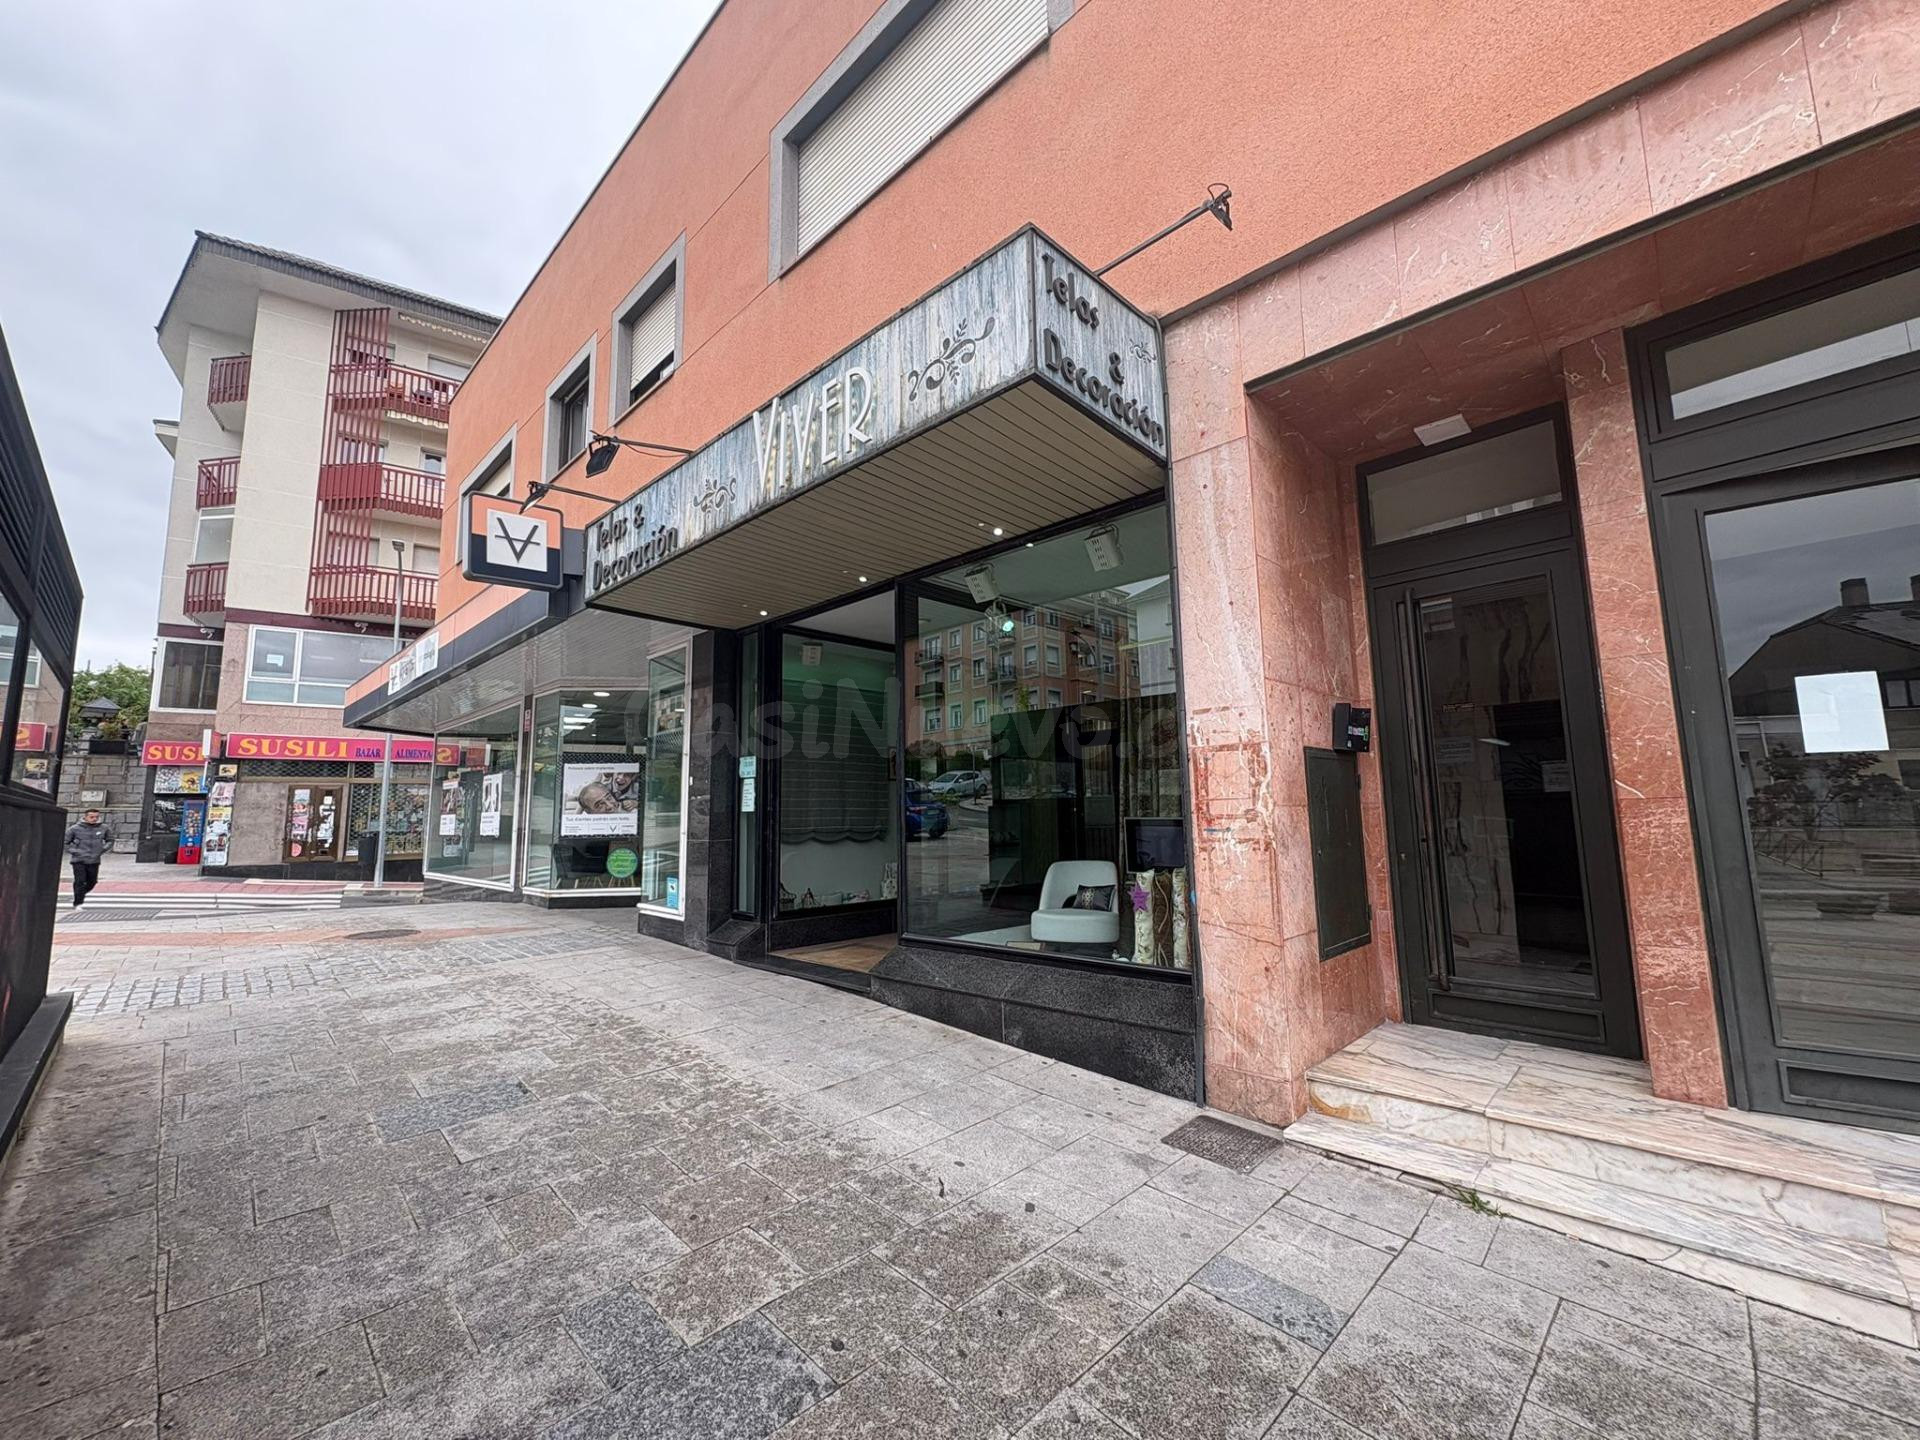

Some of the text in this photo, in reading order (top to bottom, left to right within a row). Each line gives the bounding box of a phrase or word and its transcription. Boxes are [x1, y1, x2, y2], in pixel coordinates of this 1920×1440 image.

[1042, 253, 1124, 384] Telas &
[753, 367, 873, 496] VIVER
[1043, 328, 1164, 446] Decoración
[593, 524, 678, 590] Decoración
[596, 503, 645, 551] Telas &
[237, 738, 348, 758] SUSILI
[355, 747, 381, 758] BAZAR
